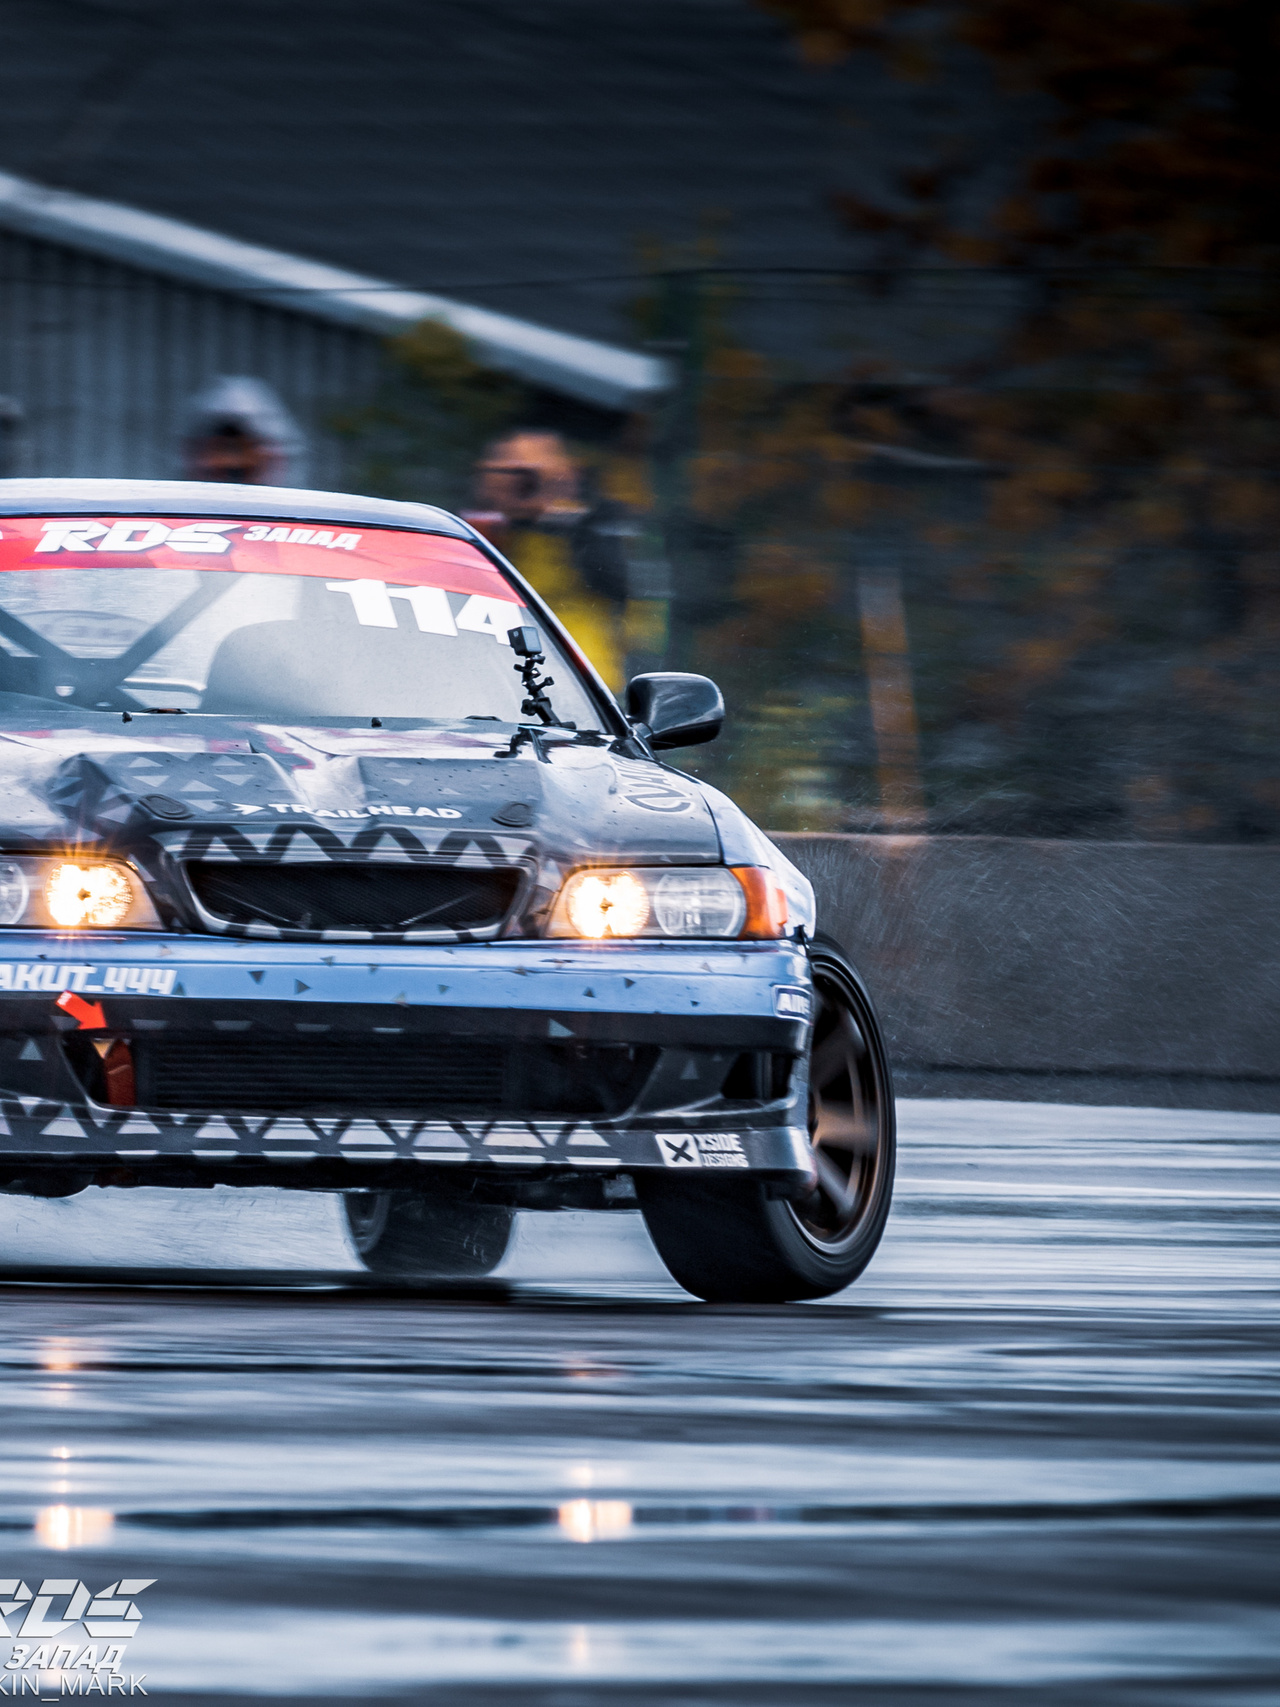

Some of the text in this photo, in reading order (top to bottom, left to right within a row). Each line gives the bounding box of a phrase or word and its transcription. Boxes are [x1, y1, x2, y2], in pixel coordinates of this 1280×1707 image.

[34, 521, 243, 553] RDS
[242, 525, 362, 551] ЗАПАД
[325, 578, 525, 646] 114
